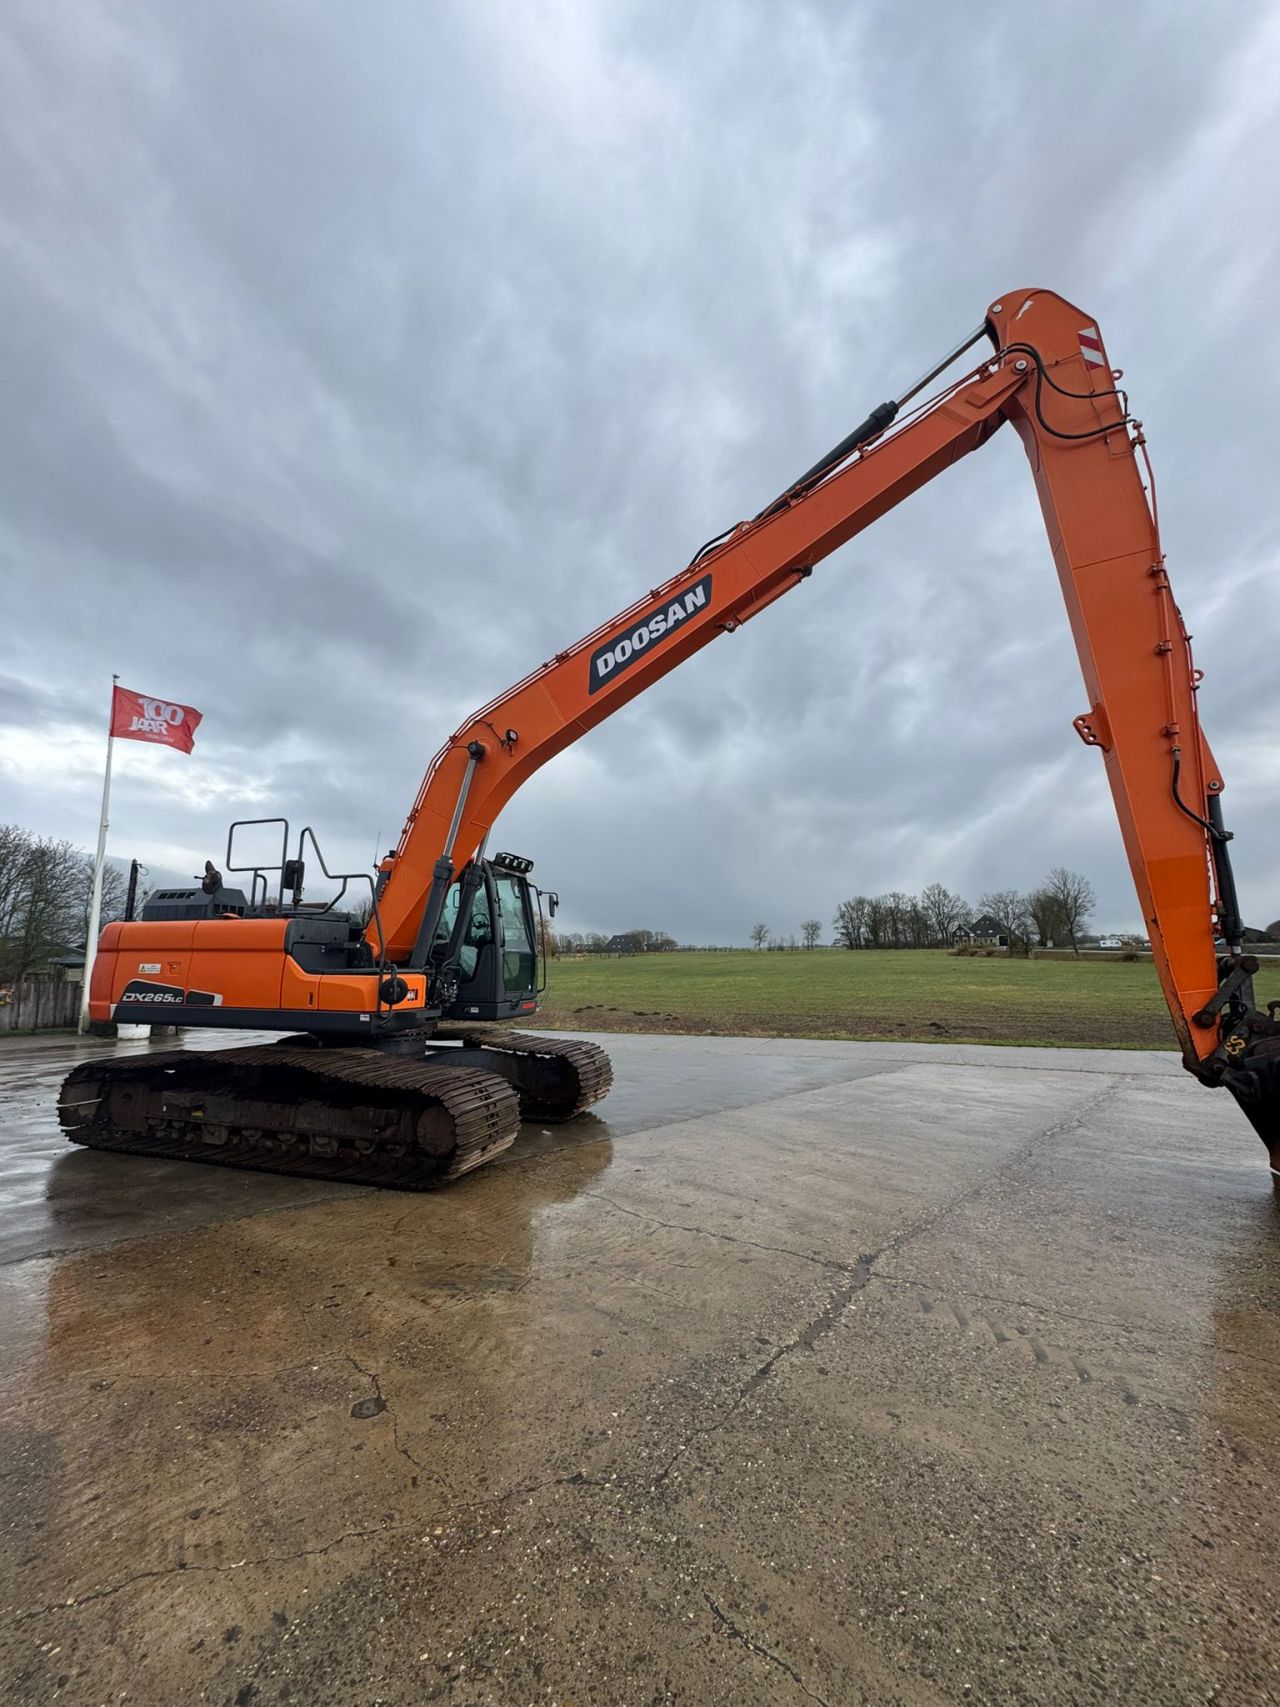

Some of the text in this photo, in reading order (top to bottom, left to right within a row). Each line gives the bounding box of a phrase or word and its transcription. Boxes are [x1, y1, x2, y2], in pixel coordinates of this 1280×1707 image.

[596, 585, 706, 677] DOOSAN
[137, 698, 185, 726] 100
[129, 716, 168, 735] JAAR
[122, 992, 183, 1003] DX265LC
